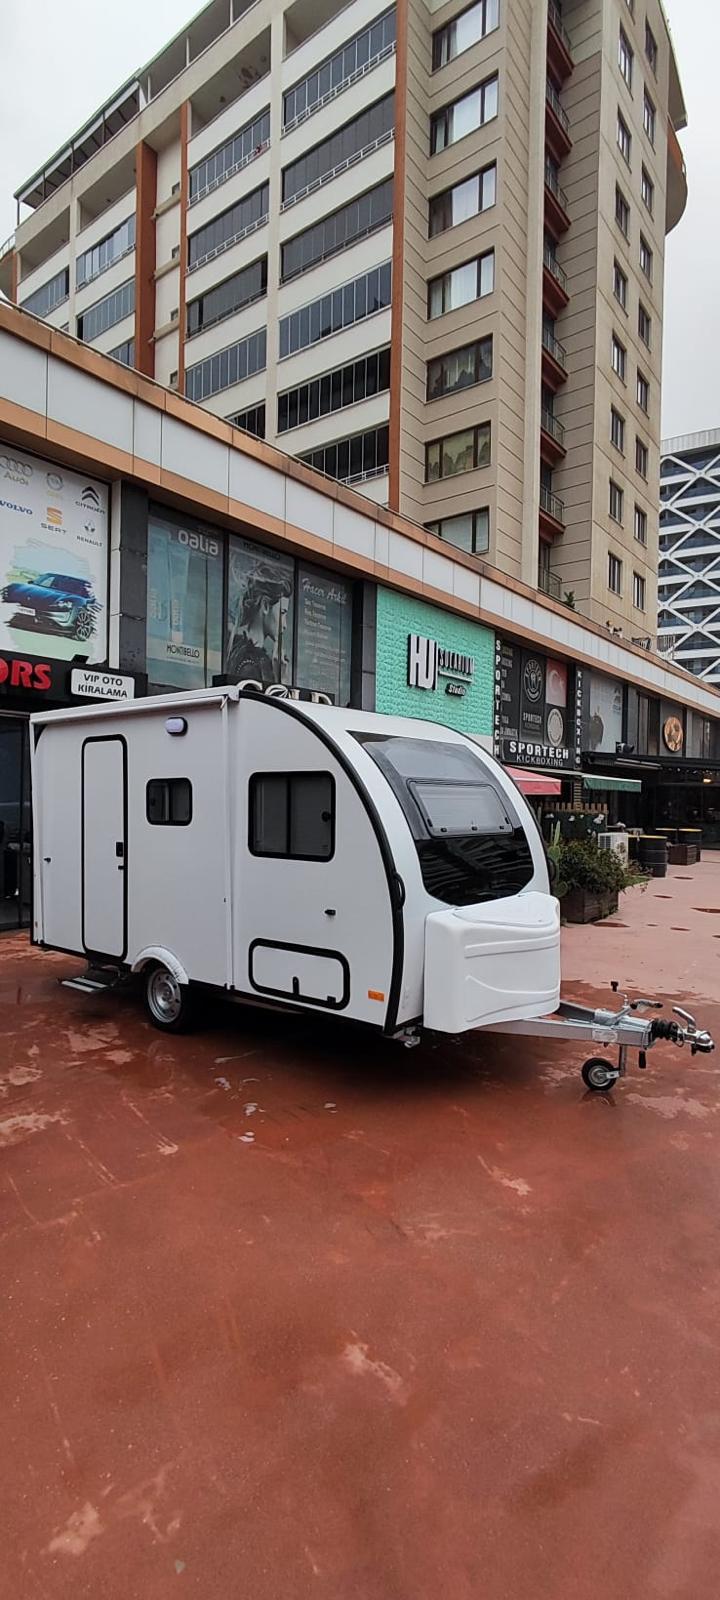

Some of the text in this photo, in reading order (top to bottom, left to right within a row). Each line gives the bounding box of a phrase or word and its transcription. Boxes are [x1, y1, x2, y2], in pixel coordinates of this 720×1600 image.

[0, 500, 33, 515] VOLVO
[40, 522, 67, 534] SEAT
[76, 535, 103, 548] RENAULT
[178, 529, 219, 556] oalia
[83, 673, 123, 686] VIP OTO
[78, 683, 128, 698] KIRALAMA
[509, 741, 569, 760] SPORTECH
[516, 754, 564, 767] KICKBOXING
